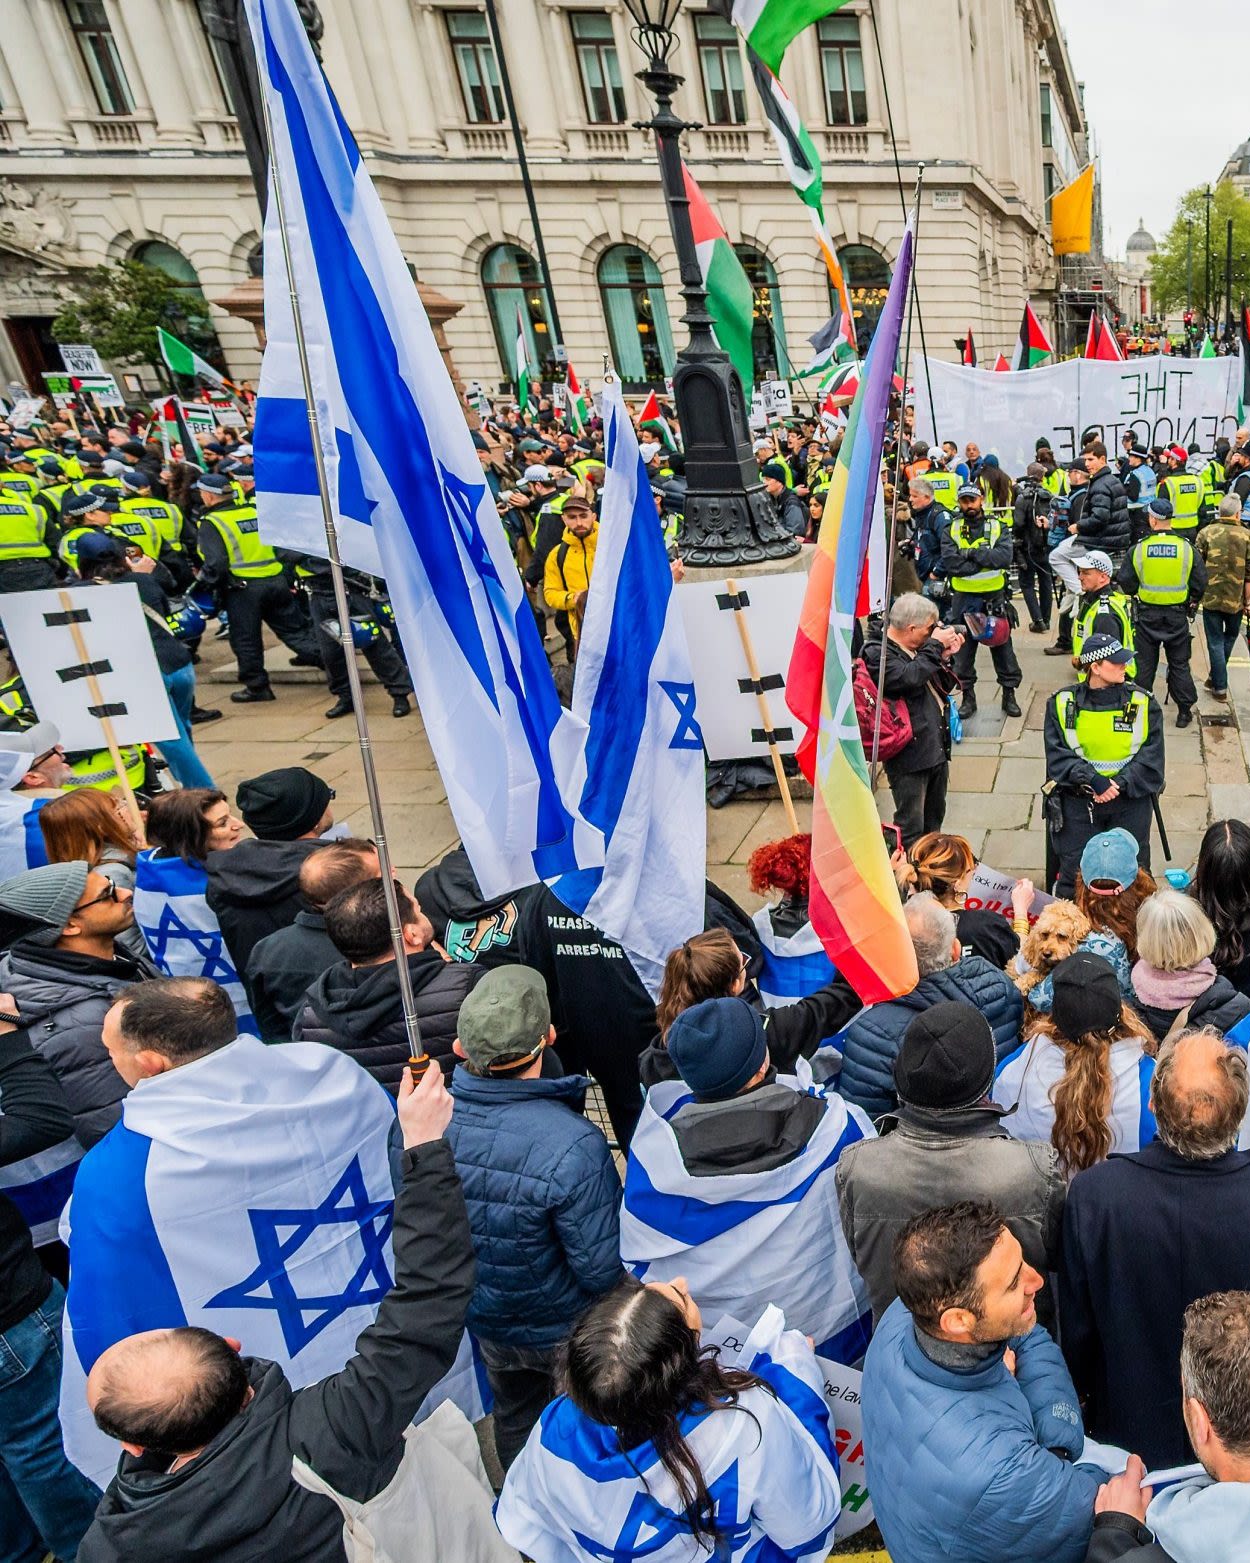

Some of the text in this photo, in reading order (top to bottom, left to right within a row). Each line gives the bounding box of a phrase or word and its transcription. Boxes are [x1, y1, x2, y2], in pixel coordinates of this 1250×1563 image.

[1148, 545, 1176, 556] POLICE
[547, 915, 592, 930] PLEASE
[602, 946, 623, 958] ME
